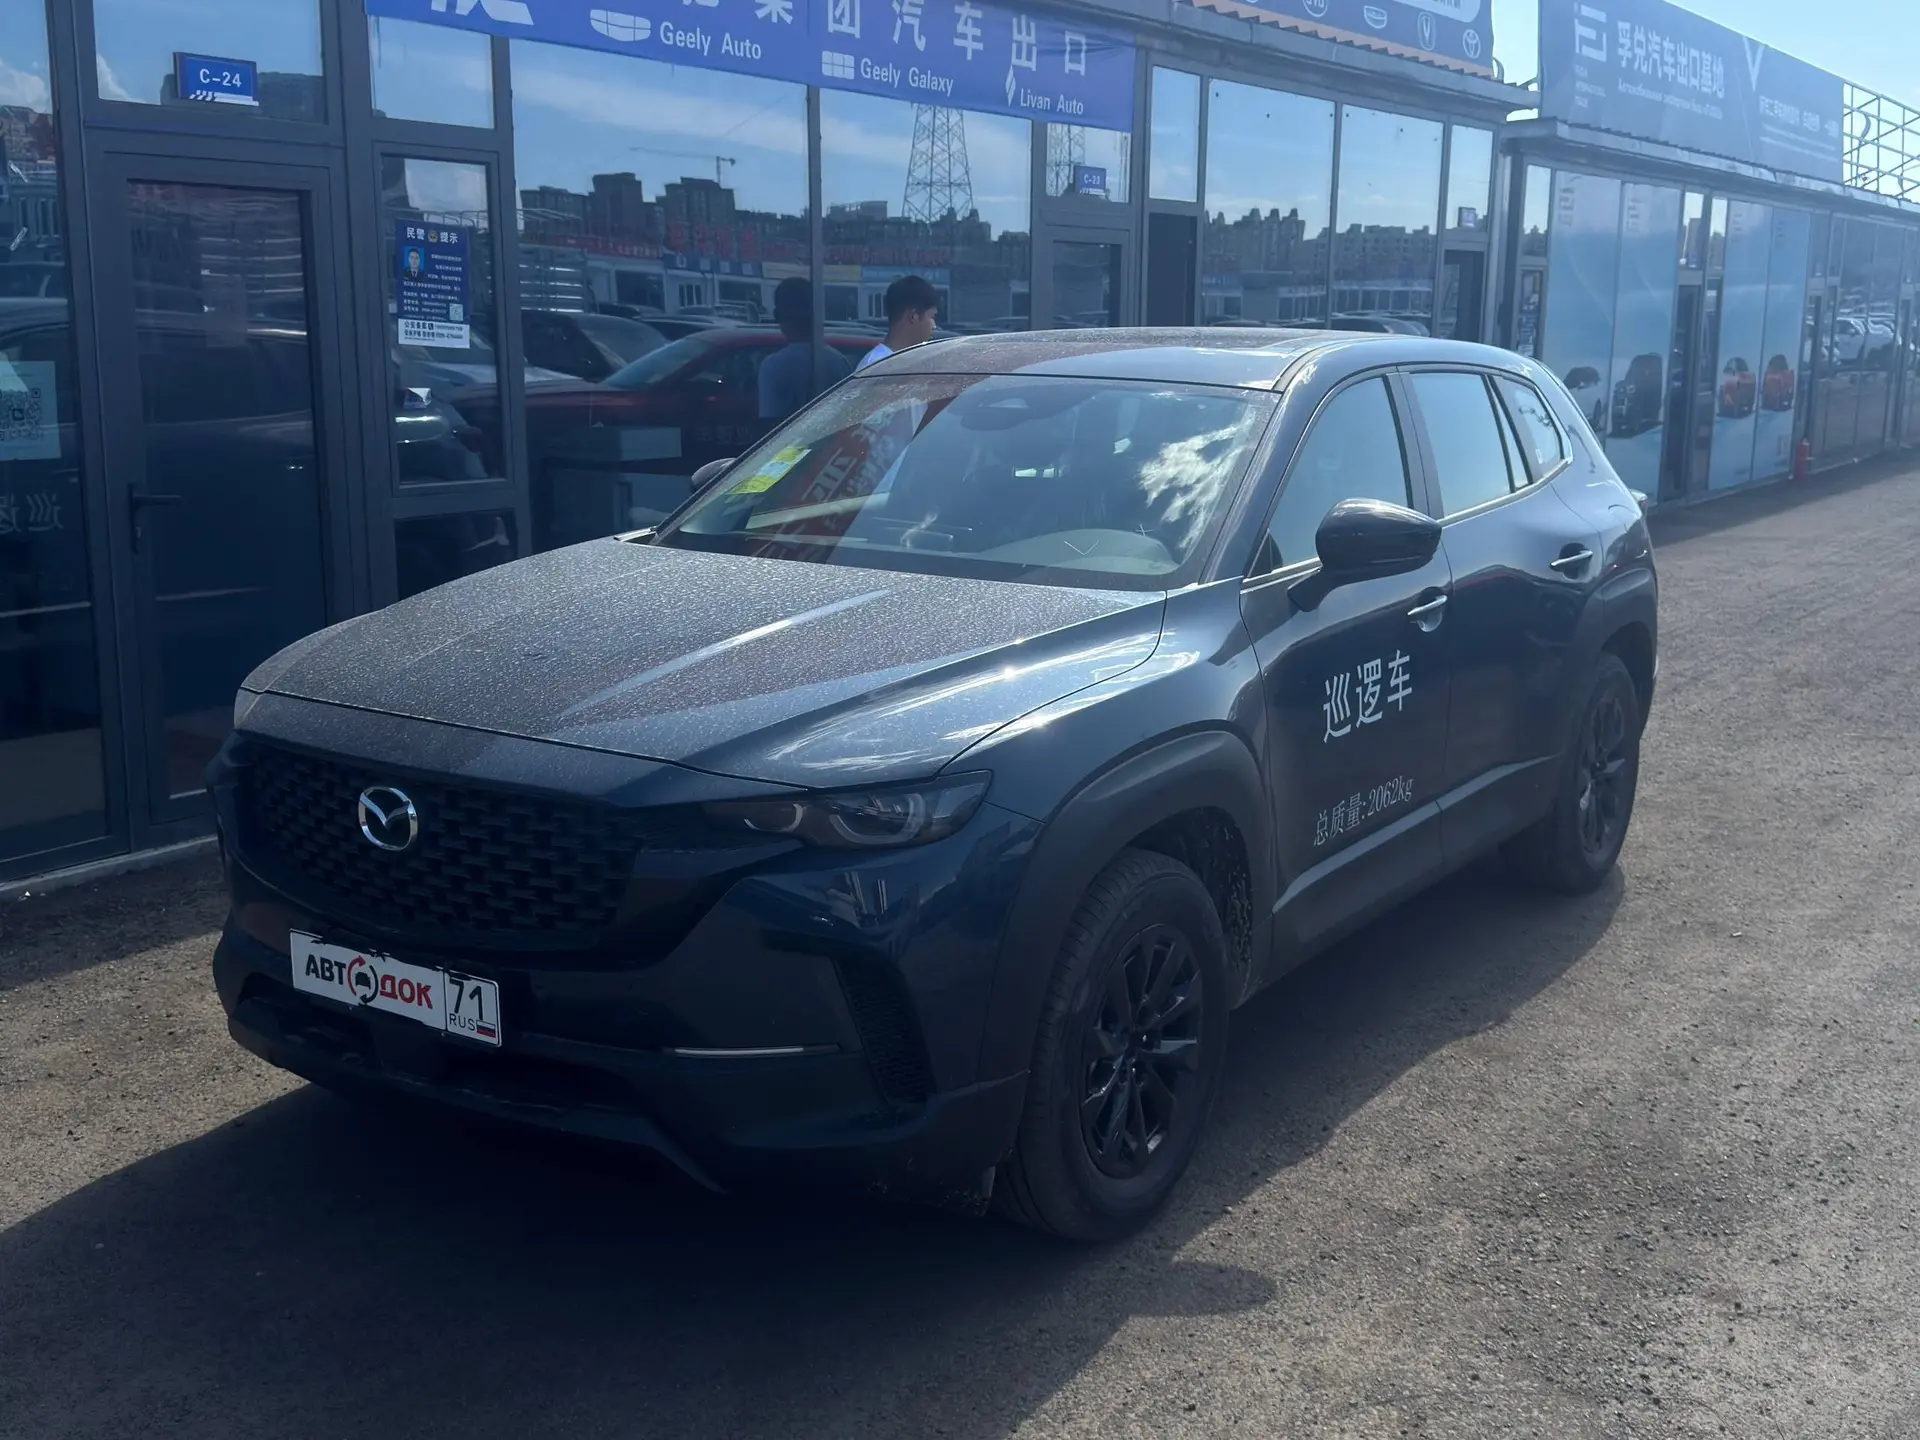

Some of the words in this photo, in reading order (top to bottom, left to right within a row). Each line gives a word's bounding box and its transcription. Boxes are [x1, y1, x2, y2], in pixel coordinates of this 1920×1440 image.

[660, 21, 711, 57] Geely
[721, 32, 762, 60] Auto
[199, 68, 242, 88] C-24
[860, 57, 901, 89] Geely
[908, 66, 954, 97] Galaxy
[1020, 87, 1051, 111] Livan
[1056, 93, 1084, 115] Auto
[1323, 649, 1412, 743] 巡逻车
[449, 979, 484, 1021] 71
[449, 1012, 476, 1031] RUS
